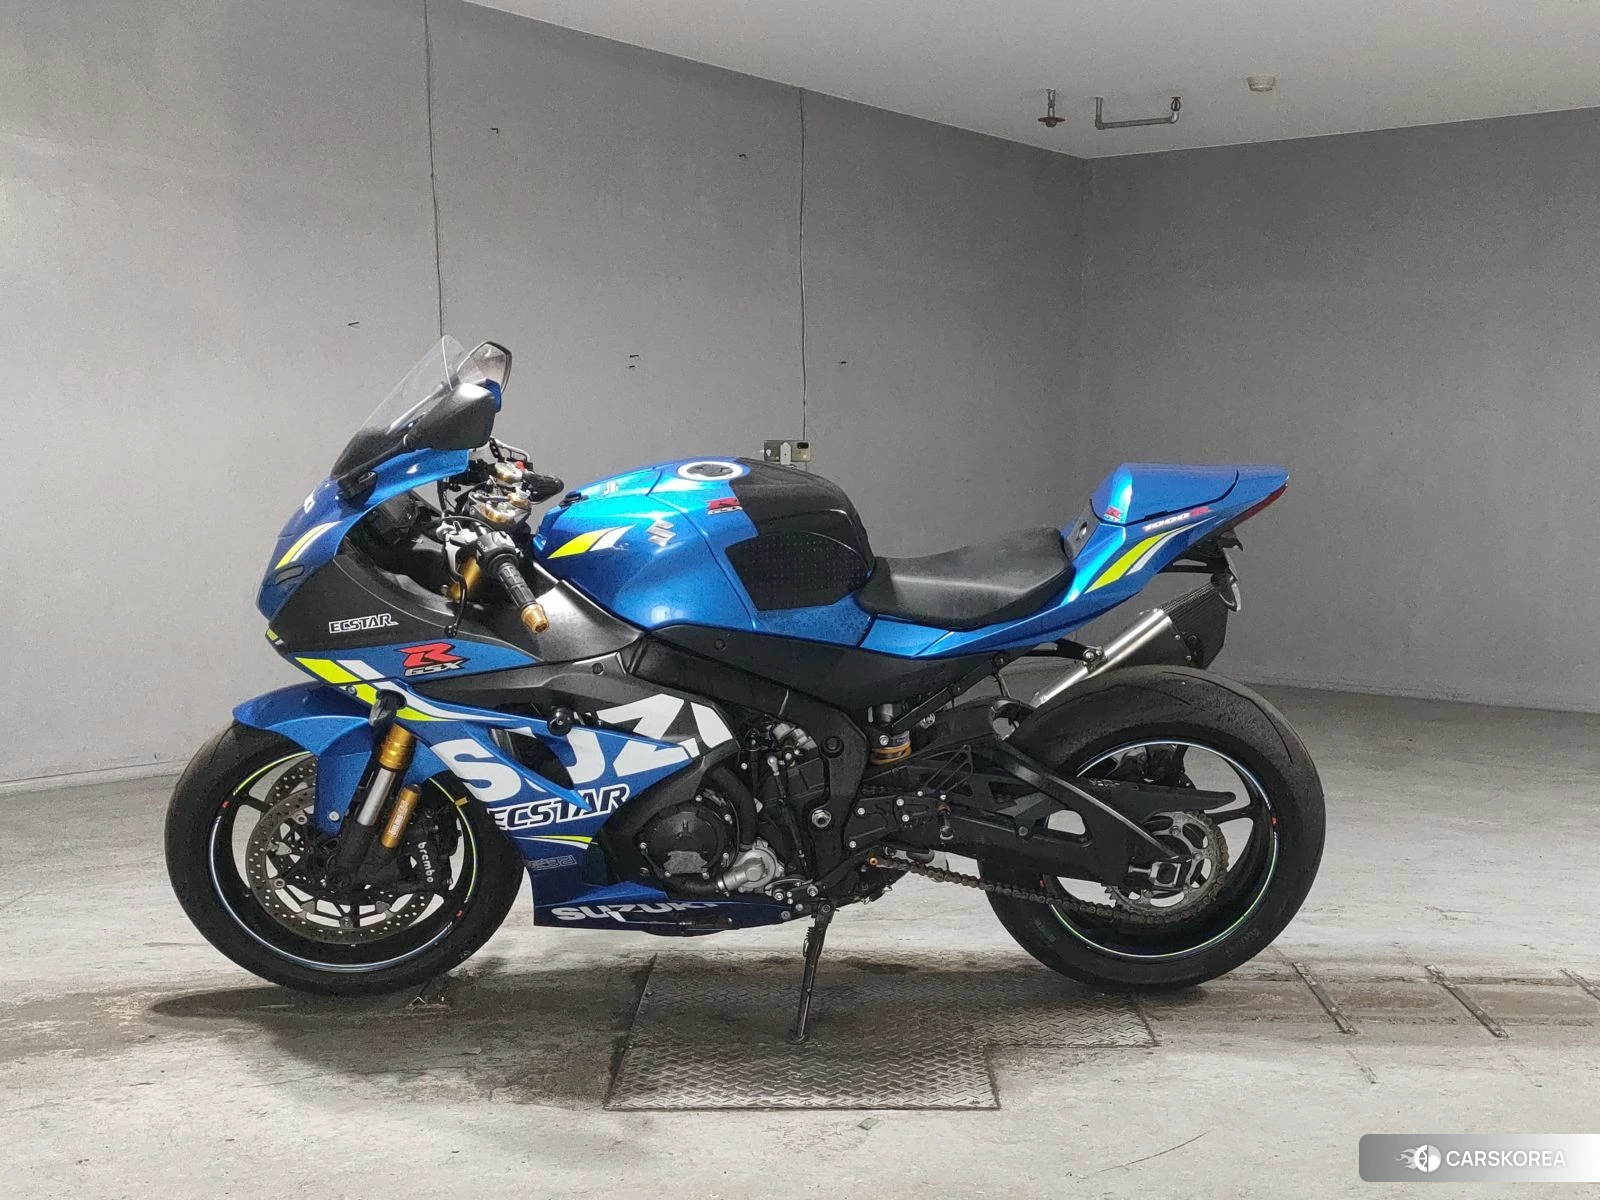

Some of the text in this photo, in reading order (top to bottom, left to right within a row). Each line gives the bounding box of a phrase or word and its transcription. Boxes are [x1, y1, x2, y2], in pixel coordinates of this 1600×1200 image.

[328, 613, 399, 634] ECSTAR
[399, 642, 464, 668] R
[404, 660, 463, 677] GSX
[487, 783, 630, 831] ECSTAR
[417, 841, 436, 883] brembo
